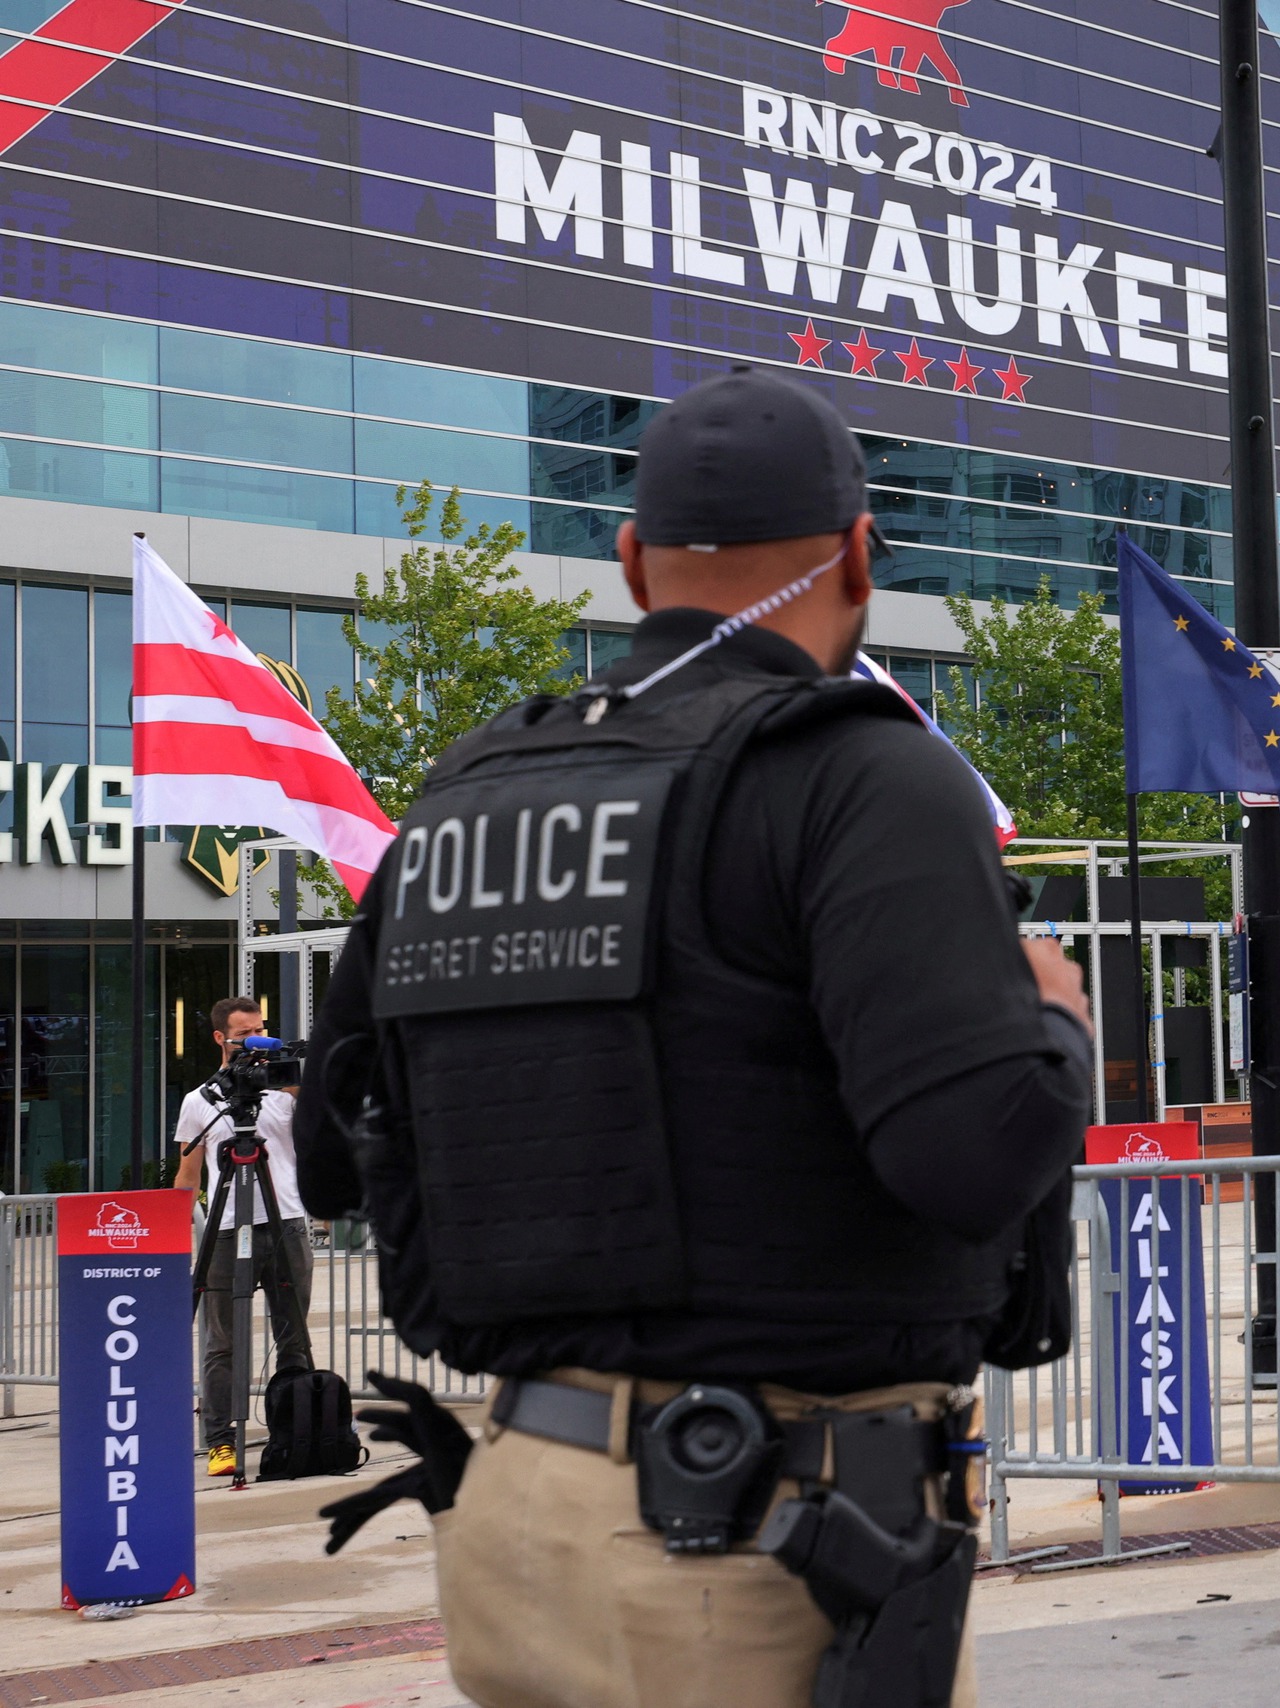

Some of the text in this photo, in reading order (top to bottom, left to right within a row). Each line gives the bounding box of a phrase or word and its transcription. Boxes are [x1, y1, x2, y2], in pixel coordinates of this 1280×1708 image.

[742, 81, 1057, 216] RNC 2024
[494, 112, 1228, 378] MILWAUKEE
[395, 801, 640, 919] POLICE
[386, 924, 622, 985] SECRET SERVICE
[83, 1267, 161, 1278] DISTRICT OF
[88, 1228, 150, 1237] MILWAUKEE
[1130, 1193, 1182, 1462] ALASKA
[105, 1295, 140, 1572] COLUMBIA
